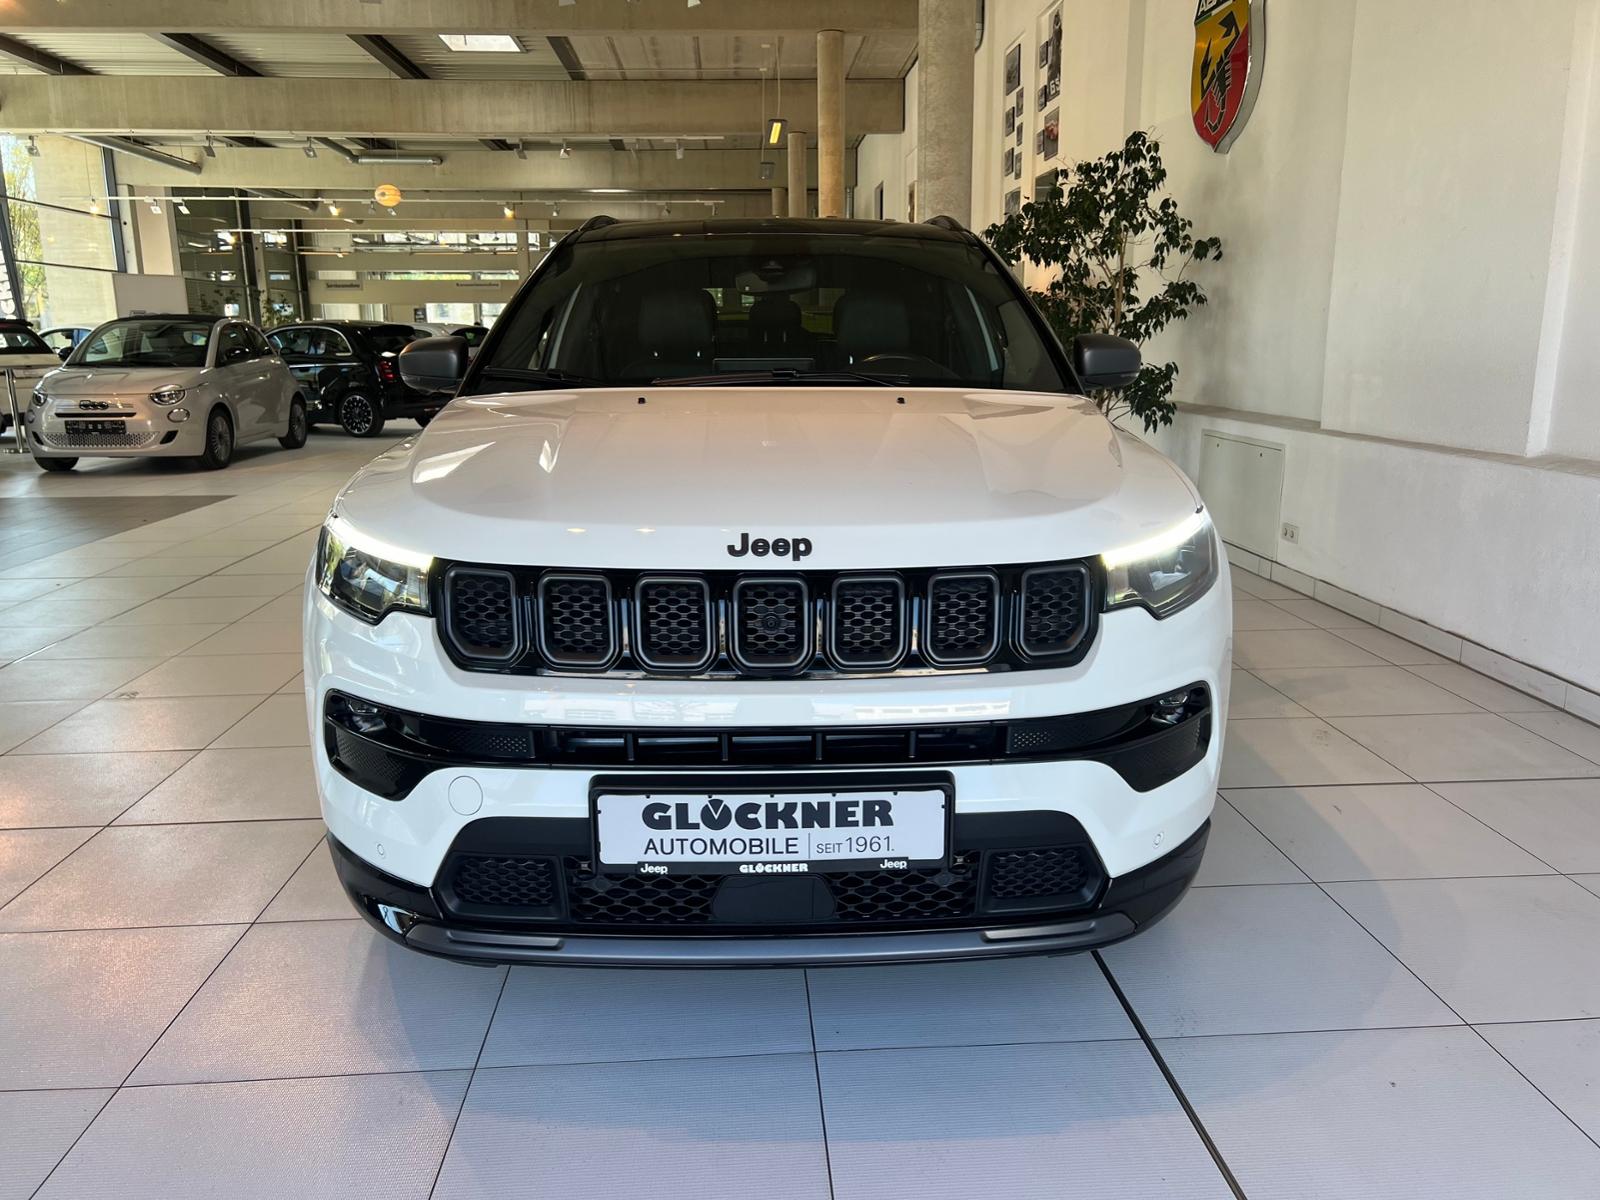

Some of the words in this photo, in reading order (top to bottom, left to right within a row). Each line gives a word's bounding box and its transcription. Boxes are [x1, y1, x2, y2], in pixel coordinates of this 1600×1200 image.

[727, 532, 813, 561] Jeep
[643, 837, 800, 855] AUTOMOBILE
[816, 842, 843, 854] SEIT
[640, 863, 669, 875] Jeep
[880, 859, 908, 870] Jeep
